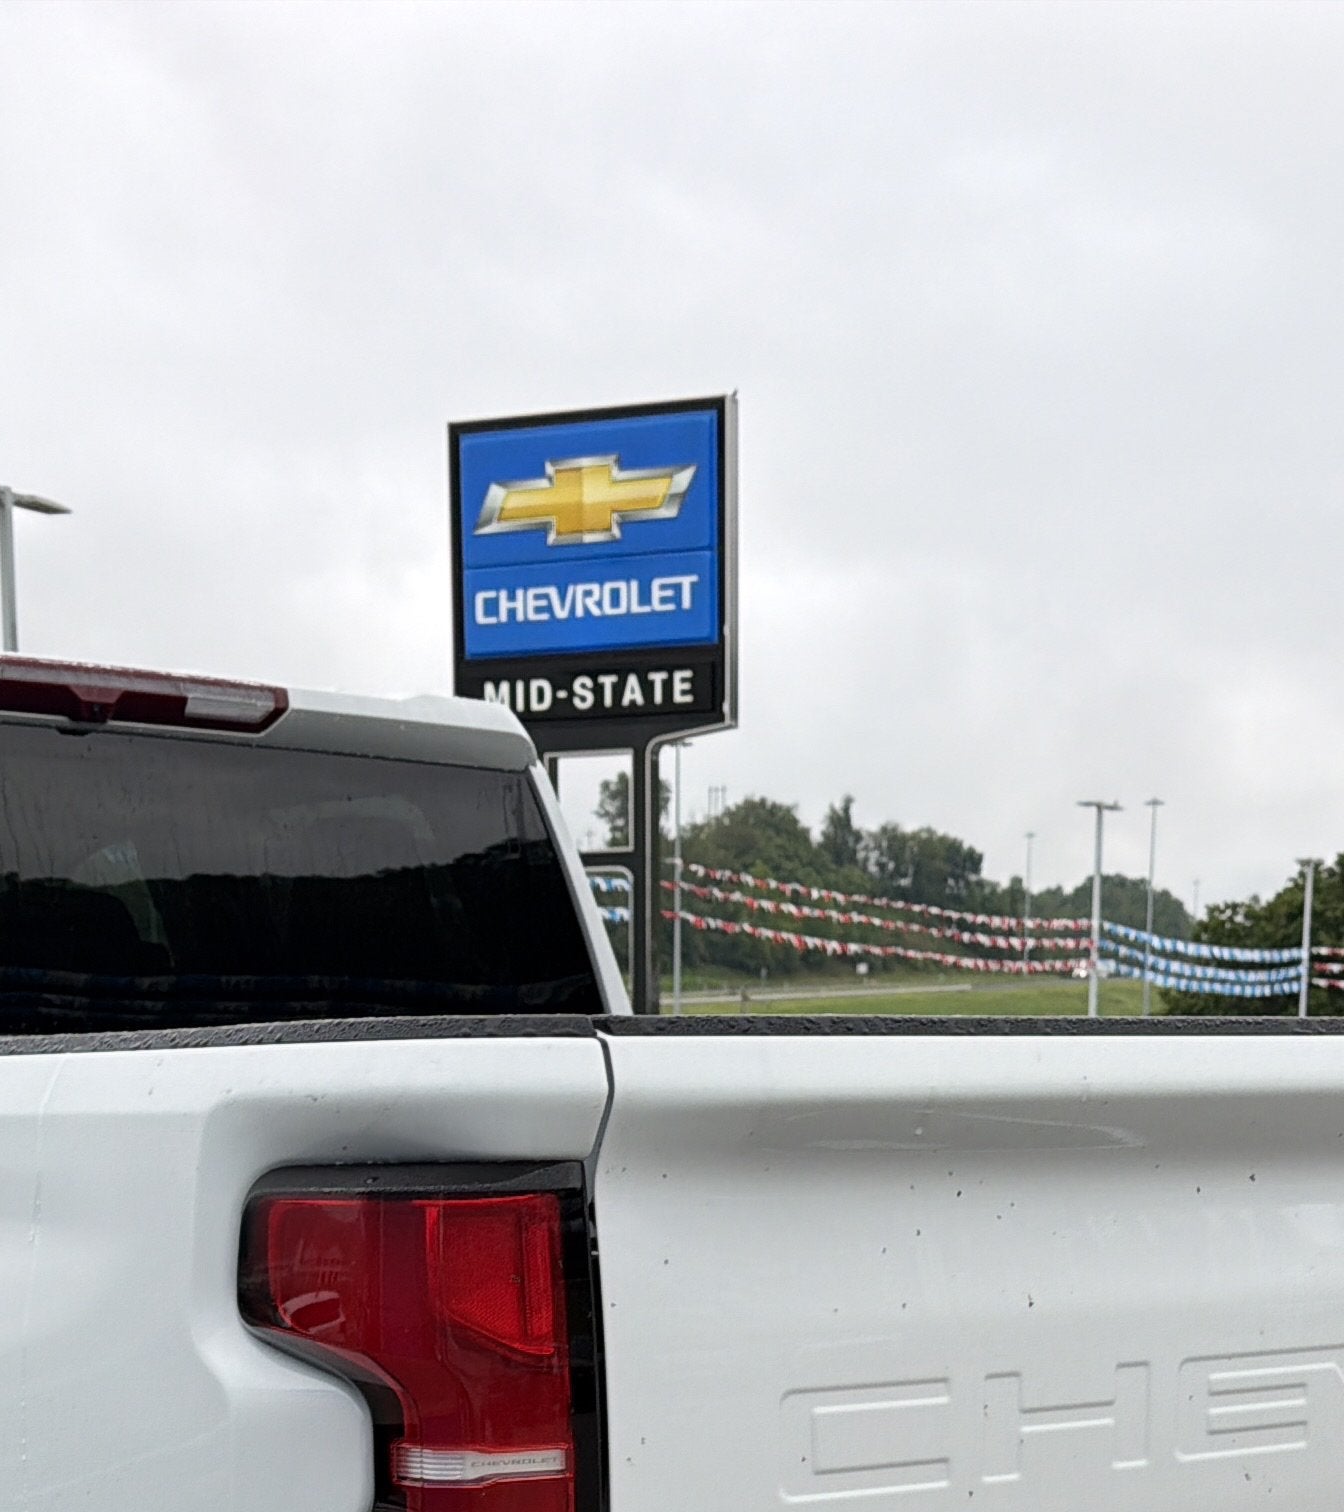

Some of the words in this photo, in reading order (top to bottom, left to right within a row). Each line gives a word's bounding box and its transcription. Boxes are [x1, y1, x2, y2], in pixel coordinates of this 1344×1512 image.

[473, 574, 700, 625] CHEVROLET
[483, 670, 694, 712] MID-STATE
[470, 1456, 558, 1468] CHEVROLET
